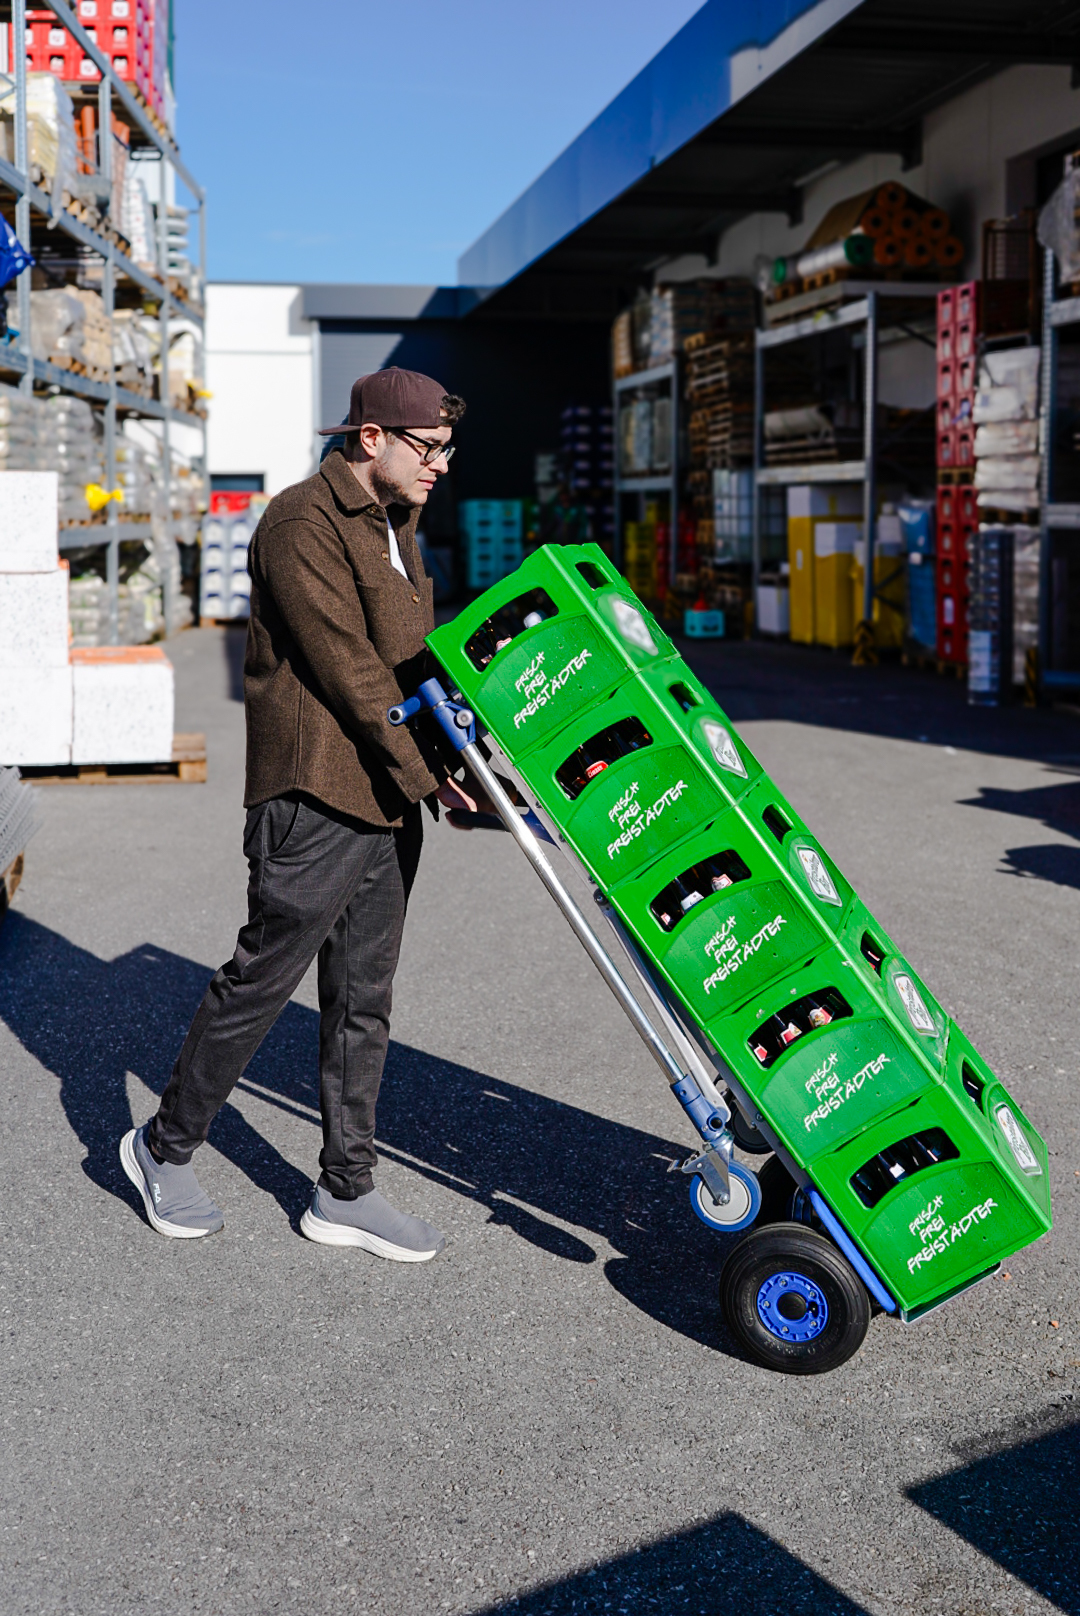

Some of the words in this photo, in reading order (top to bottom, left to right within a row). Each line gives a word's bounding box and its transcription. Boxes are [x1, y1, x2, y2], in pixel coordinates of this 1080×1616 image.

[513, 649, 592, 729] FREISTÄDTER
[514, 651, 546, 693] FRISCH
[524, 670, 547, 700] FREI
[607, 780, 688, 860] FREISTÄDTER
[608, 782, 639, 823] FRISCH
[618, 800, 642, 830] FREI
[703, 915, 787, 995] FREISTÄDTER
[704, 916, 737, 957] FRISCH
[714, 934, 739, 964] FREI
[804, 1053, 891, 1132] FREISTÄDTER
[805, 1053, 839, 1094] FRISCH
[815, 1072, 840, 1102] FREI
[153, 1183, 162, 1203] FILA
[909, 1195, 944, 1236] FRISCH
[919, 1214, 946, 1244] FREI
[907, 1198, 998, 1275] FREISTÄDTER
